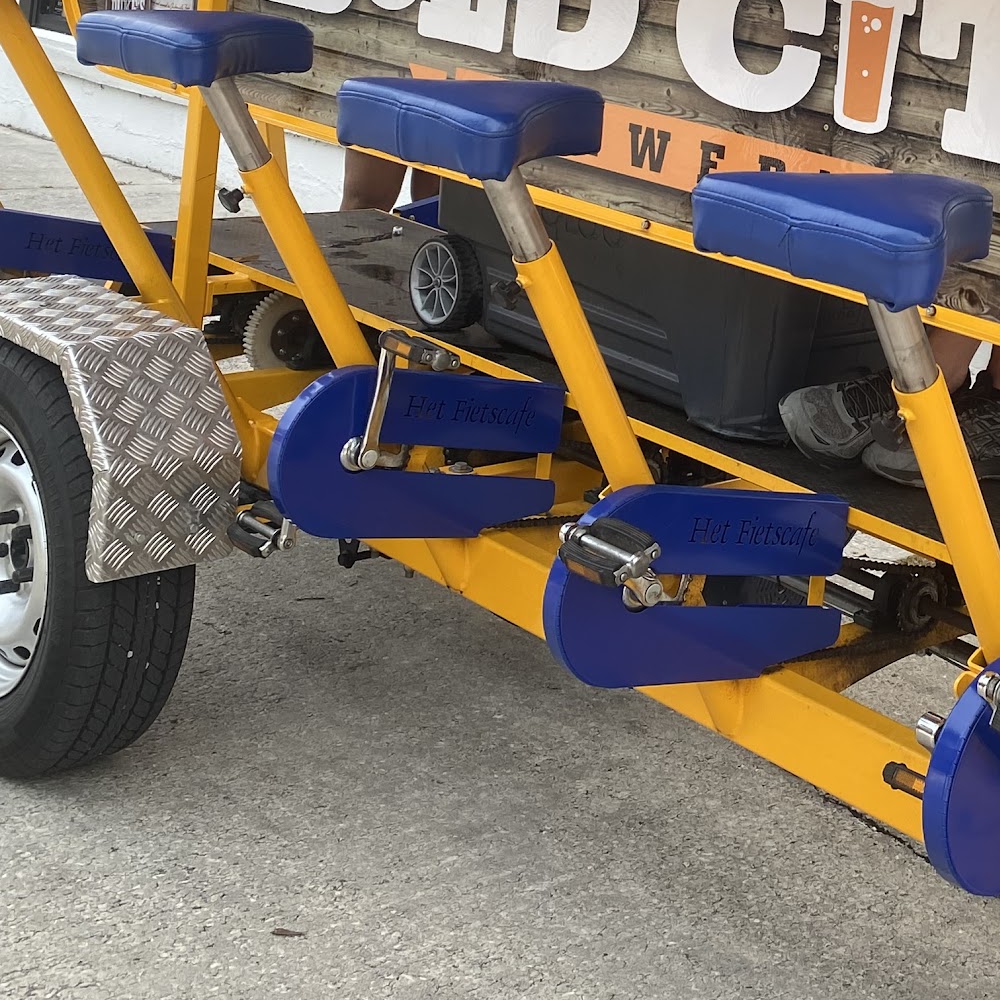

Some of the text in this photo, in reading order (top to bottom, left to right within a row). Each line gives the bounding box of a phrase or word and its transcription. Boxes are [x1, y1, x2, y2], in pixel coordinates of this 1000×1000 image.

[404, 395, 537, 435] Het Fietscafe
[688, 511, 819, 556] Het Fietscafe
